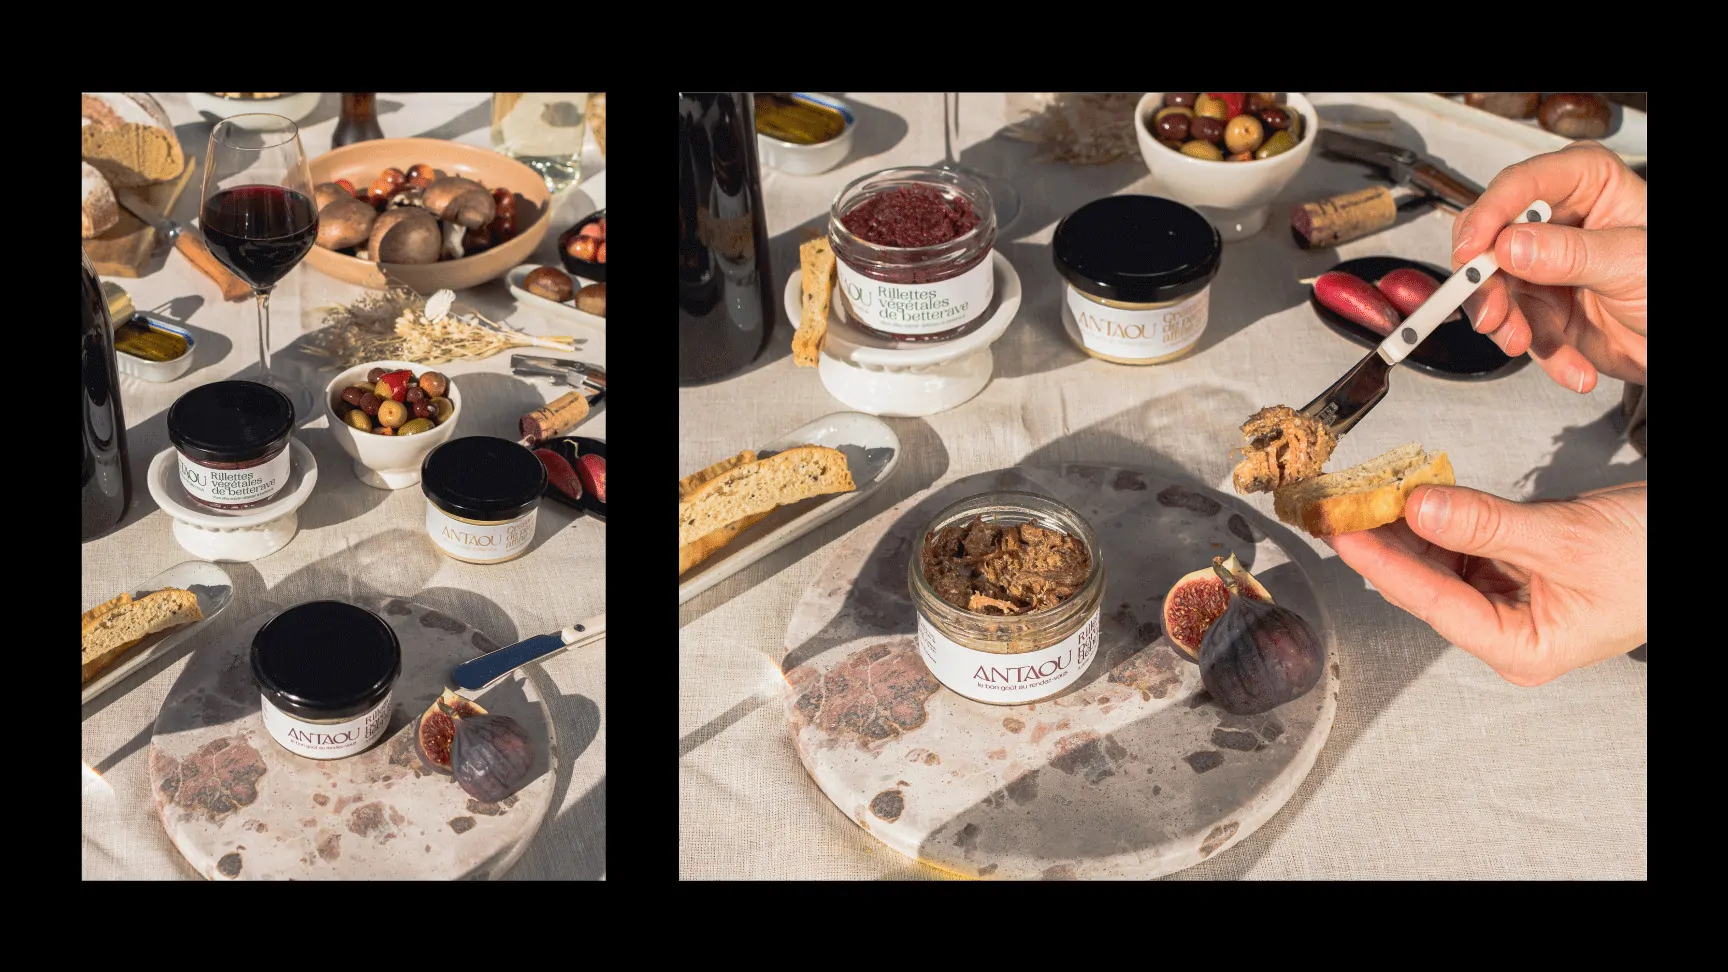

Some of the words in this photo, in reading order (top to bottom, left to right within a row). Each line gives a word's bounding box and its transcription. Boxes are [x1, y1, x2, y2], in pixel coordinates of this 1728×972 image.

[878, 285, 937, 301] Rillettes
[879, 296, 950, 313] végétales
[879, 308, 898, 321] de
[900, 301, 969, 322] betterave
[1080, 311, 1156, 339] ANTAOU
[211, 471, 254, 482] Rillettes
[211, 477, 263, 492] végétales
[211, 486, 226, 496] de
[228, 478, 276, 496] betterave
[441, 525, 502, 547] ANTAOU
[972, 650, 1072, 683] ANTAOU
[1000, 684, 1017, 692] goût
[287, 727, 360, 745] ANTAOU
